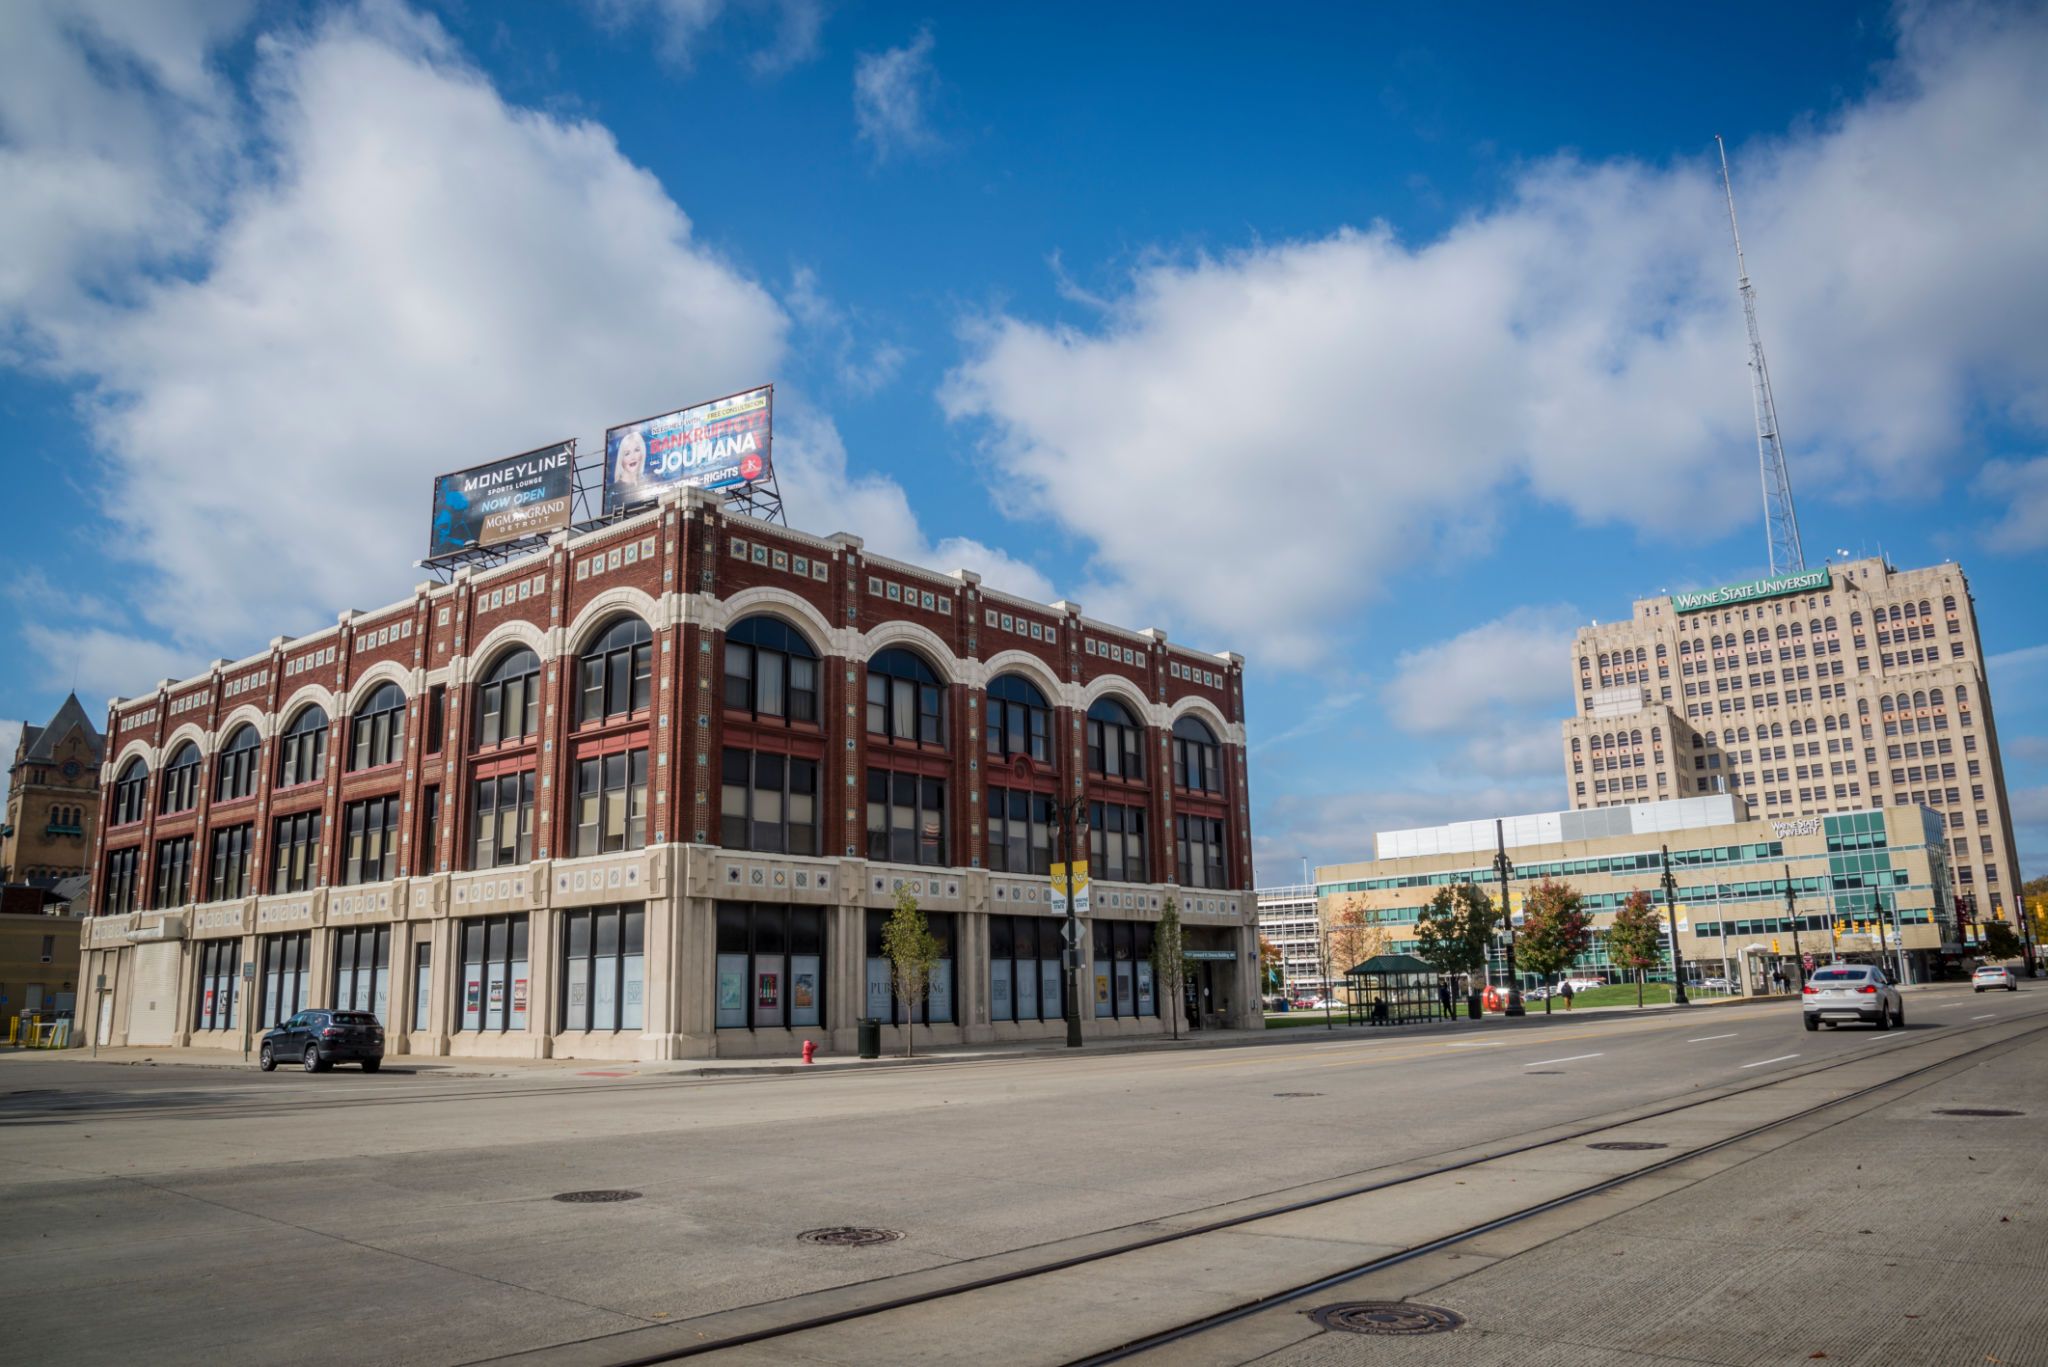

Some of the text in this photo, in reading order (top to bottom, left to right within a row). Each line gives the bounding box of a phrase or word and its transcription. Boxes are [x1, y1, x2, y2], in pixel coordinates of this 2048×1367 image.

[685, 415, 701, 425] WITH
[706, 411, 721, 420] FREE
[650, 409, 766, 454] BANKRUPTCY?
[654, 431, 757, 474] JOUMANA
[464, 452, 568, 492] MONEYLINE
[487, 476, 543, 496] SPORTS LOUNGE
[481, 486, 546, 513] NOW OPEN
[486, 501, 565, 529] MGM GRAND
[500, 516, 549, 533] DETROIT
[1676, 572, 1825, 610] WAYNE STATE UNIVERSITY
[1771, 817, 1821, 832] WAYNE STATE
[1776, 826, 1820, 839] UNIVERSITY
